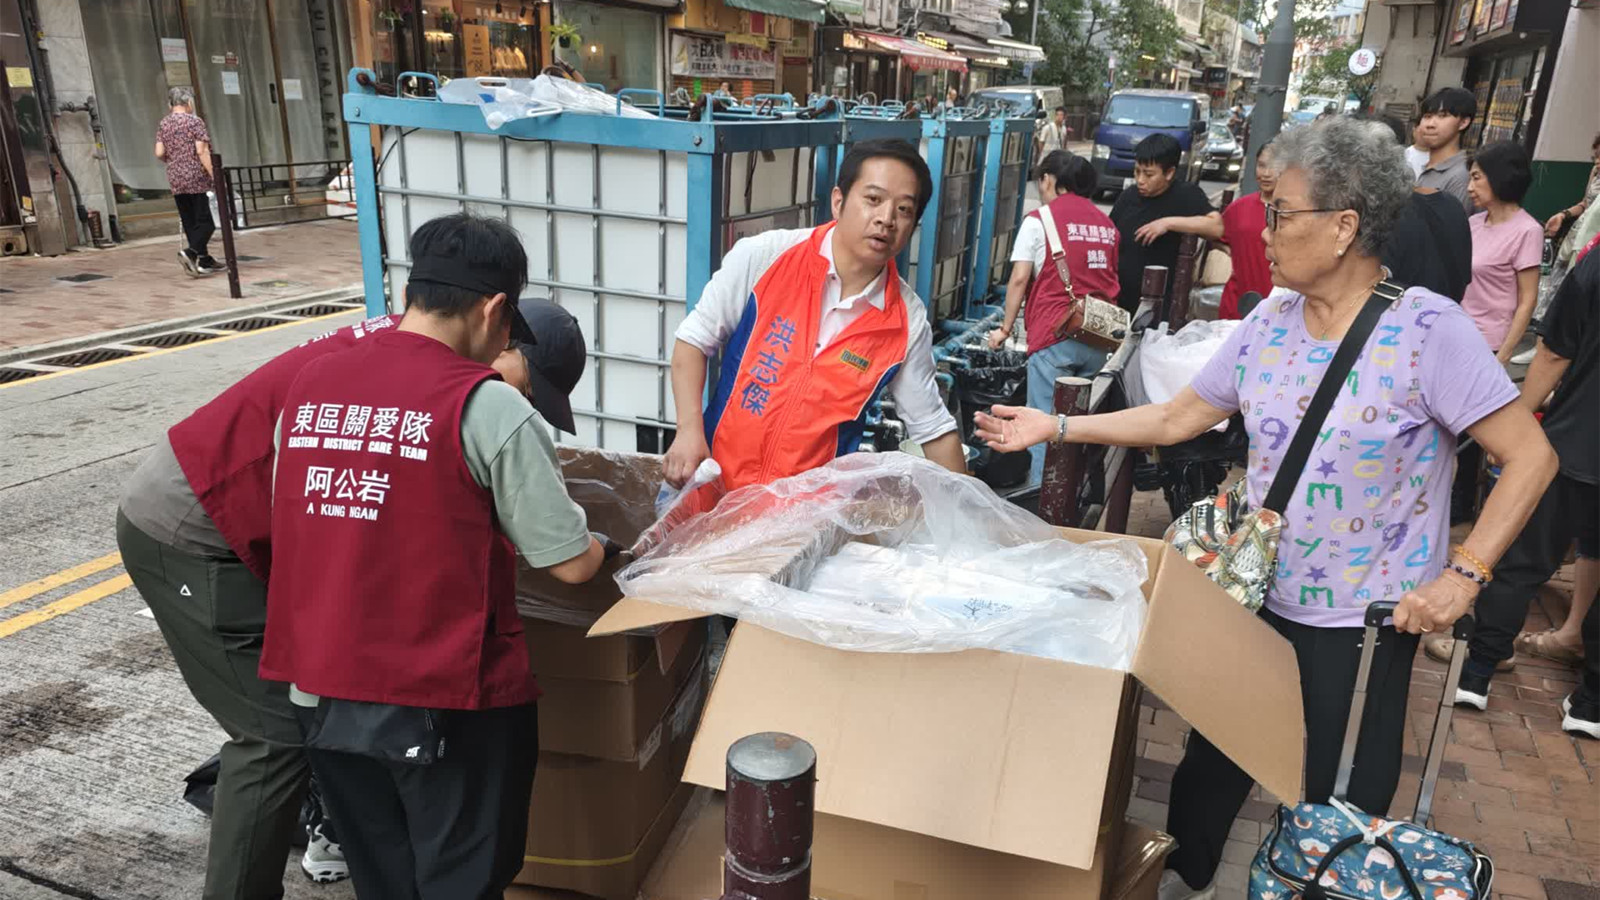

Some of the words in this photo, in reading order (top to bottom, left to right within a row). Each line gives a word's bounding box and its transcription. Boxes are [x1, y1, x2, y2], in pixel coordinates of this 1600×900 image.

[740, 315, 798, 417] 洪志傑
[291, 401, 433, 444] 東區關愛隊
[288, 436, 319, 449] EASTERN
[323, 436, 363, 451] DISTRICT
[368, 441, 392, 455] CARE
[400, 445, 428, 461] TEAM
[304, 465, 391, 504] 阿公岩
[306, 502, 314, 514] A
[320, 503, 346, 517] KUNG
[349, 506, 379, 521] NGAM
